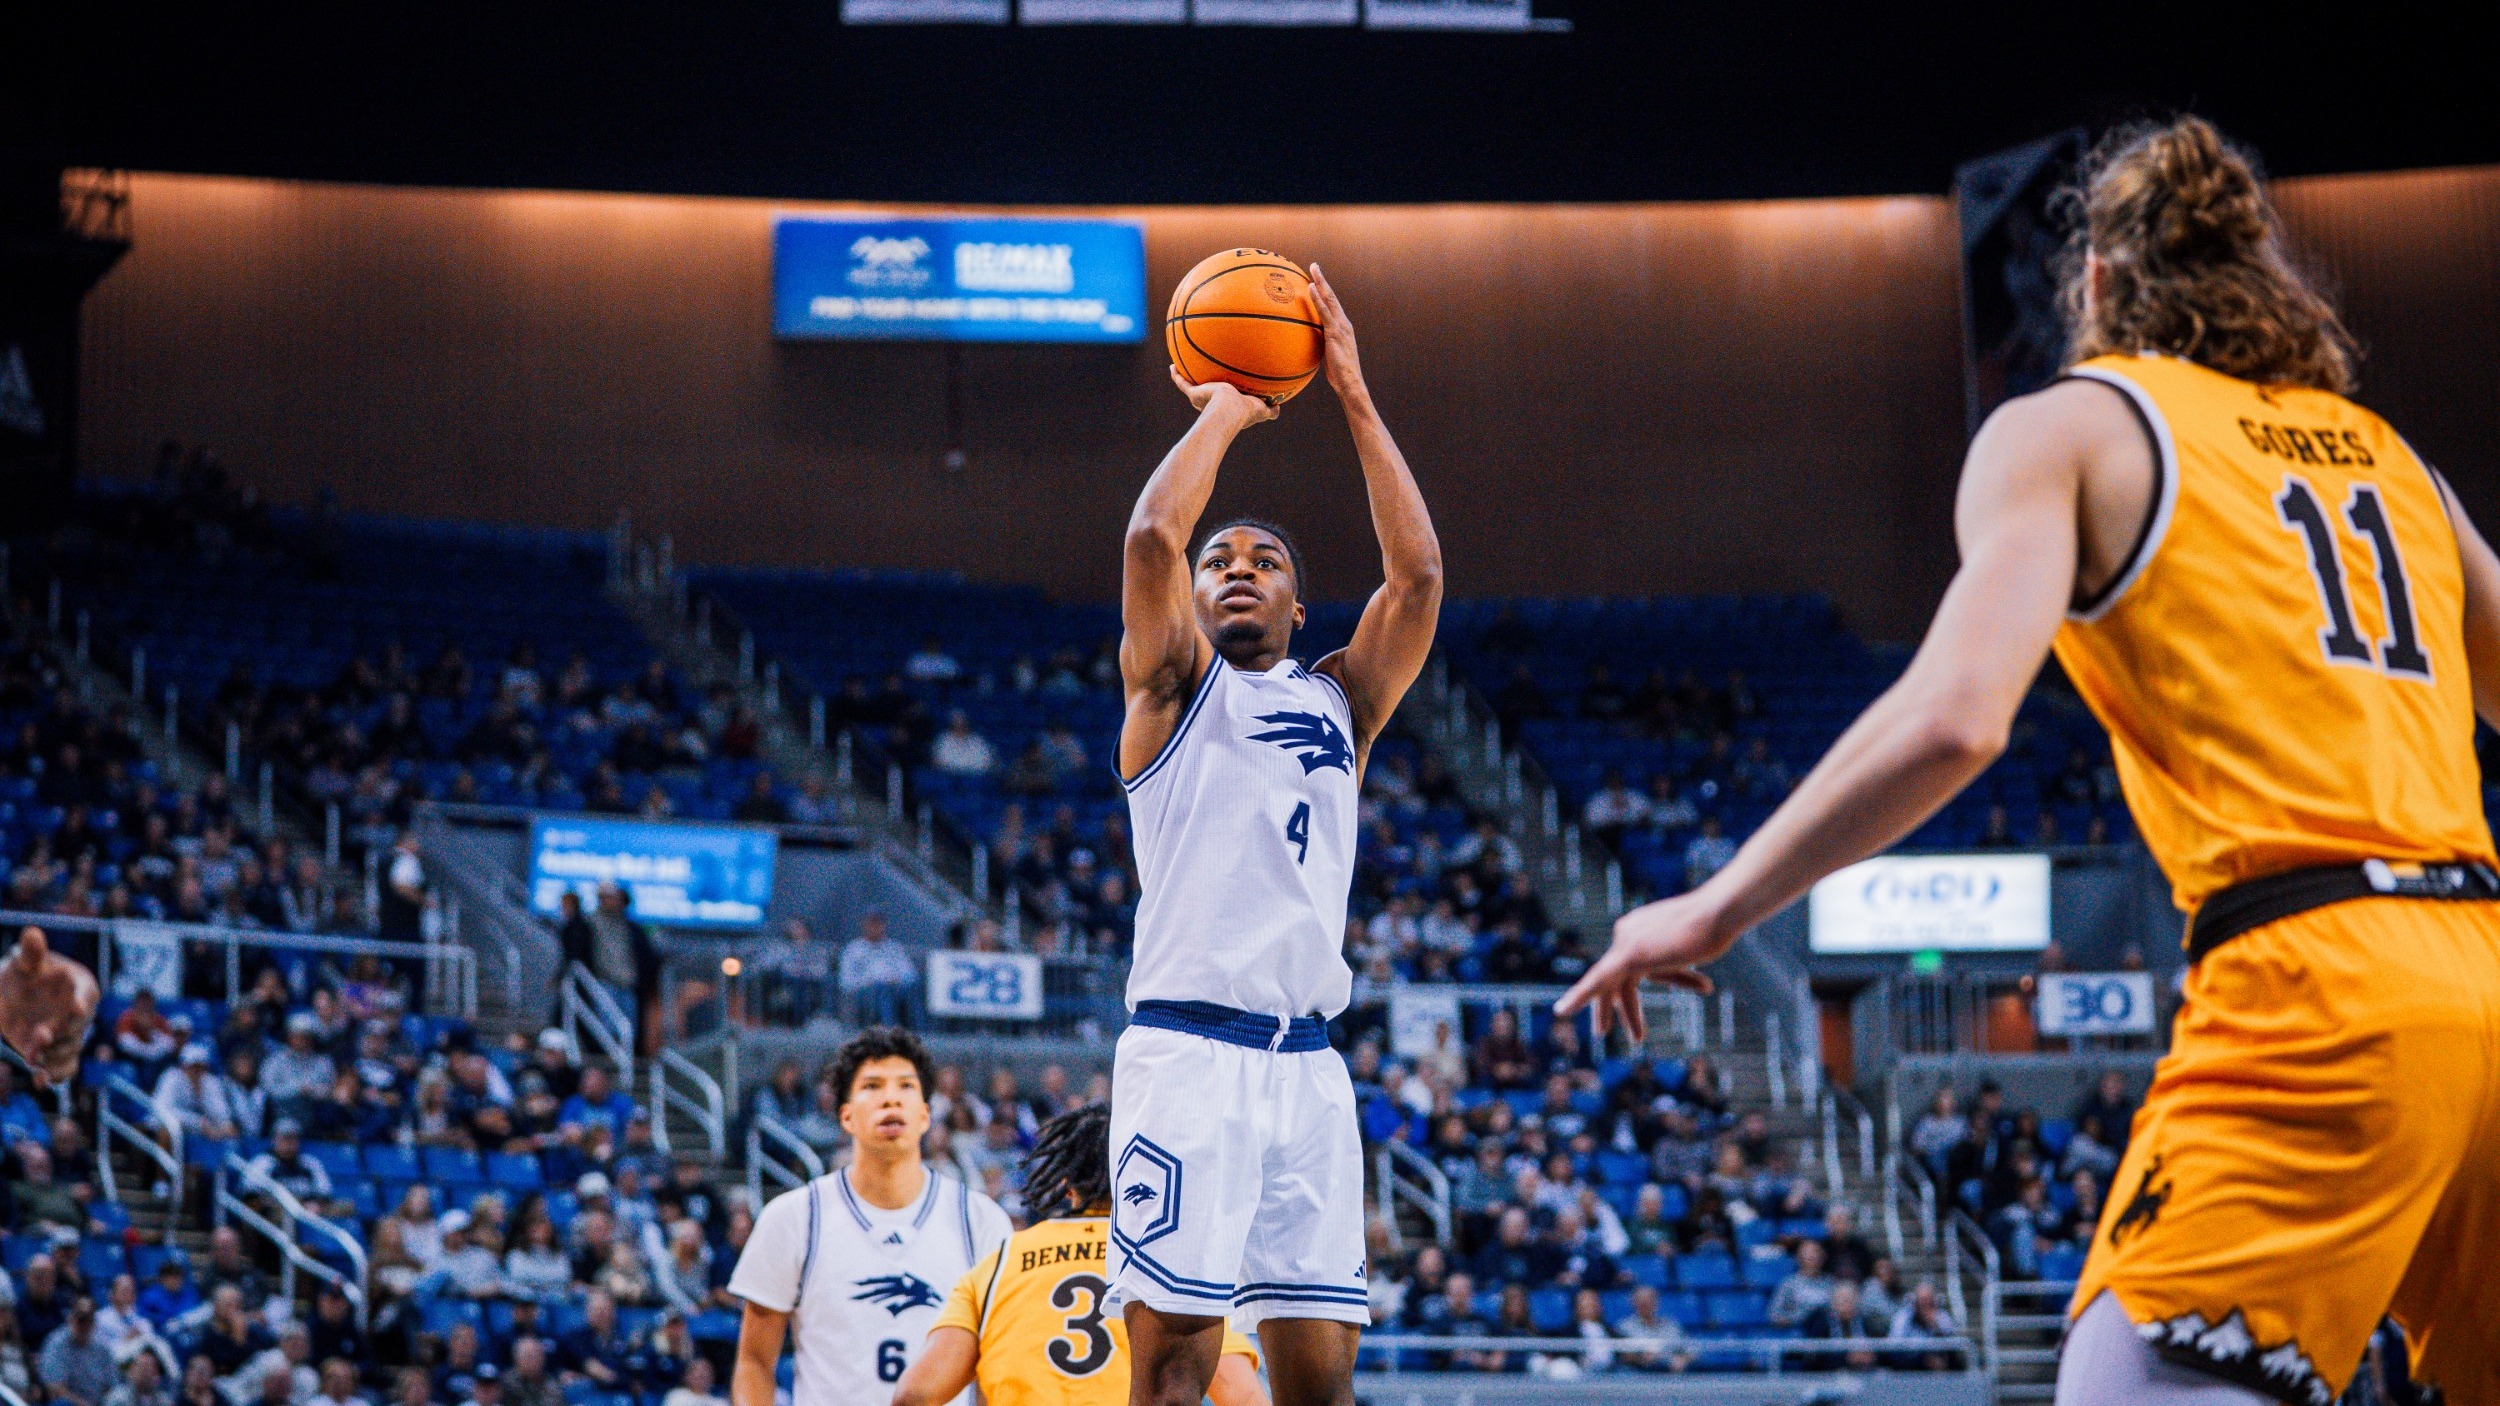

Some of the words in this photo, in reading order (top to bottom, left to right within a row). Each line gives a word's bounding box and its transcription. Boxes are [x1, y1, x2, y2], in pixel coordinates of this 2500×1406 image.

[2239, 417, 2375, 467] GORES
[2273, 474, 2434, 684] 11
[1285, 799, 1310, 867] 4
[948, 960, 1021, 1005] 28
[2061, 980, 2133, 1022] 30
[1021, 1241, 1107, 1272] BENNE
[1046, 1273, 1115, 1377] 3
[876, 1338, 907, 1383] 6
